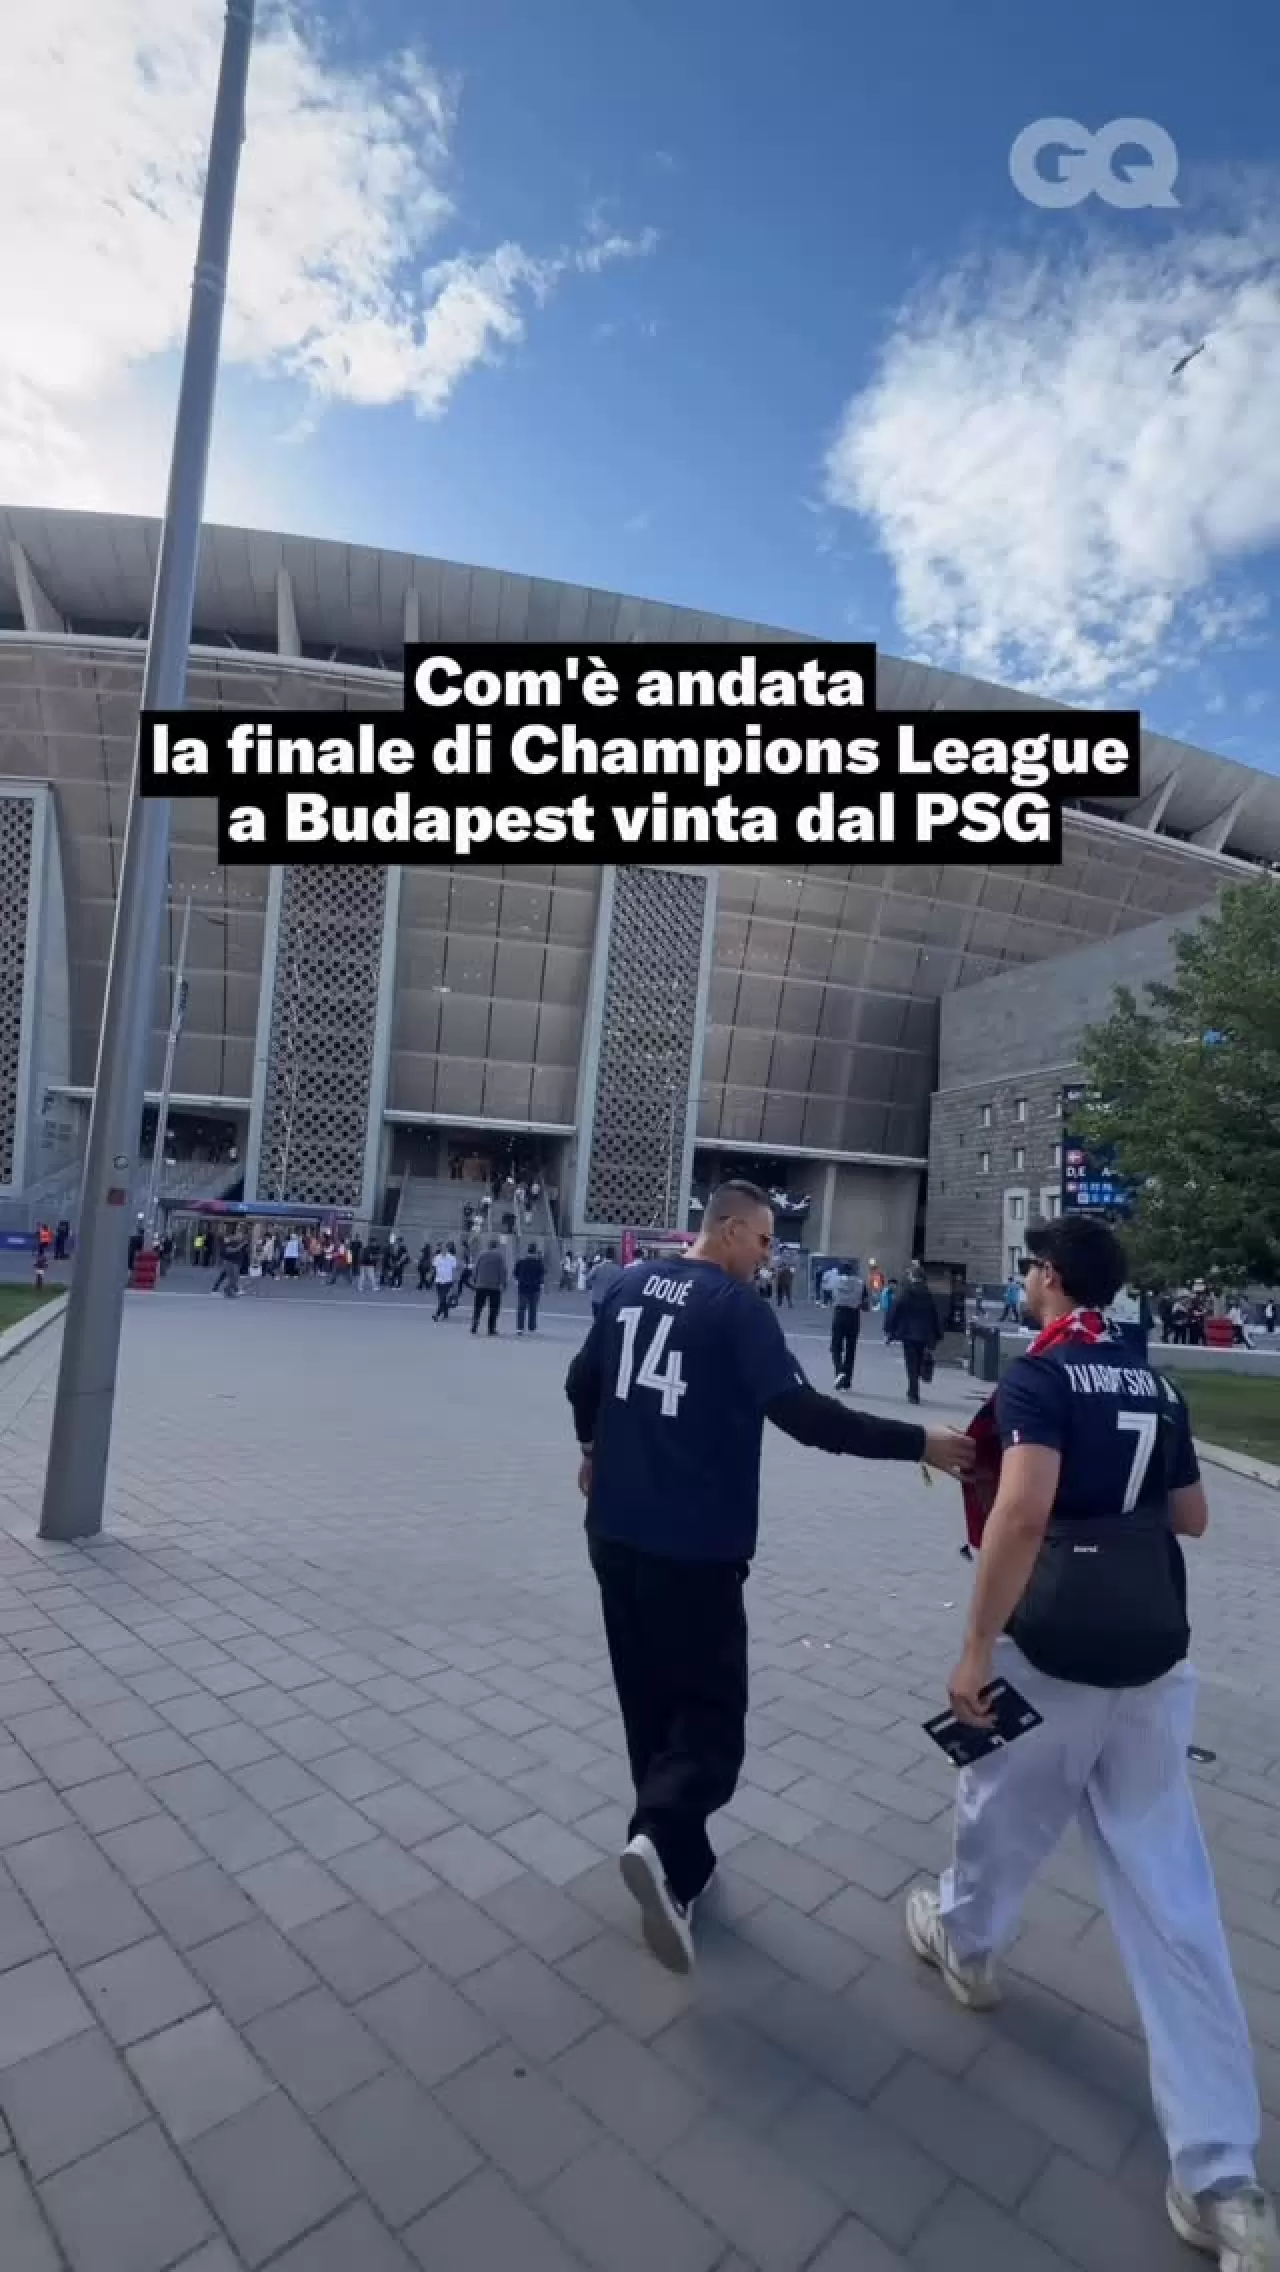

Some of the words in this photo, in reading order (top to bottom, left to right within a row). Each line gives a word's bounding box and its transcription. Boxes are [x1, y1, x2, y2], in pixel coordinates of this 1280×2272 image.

[642, 1273, 694, 1306] DOUÉ
[615, 1306, 688, 1417] 14
[1116, 1409, 1158, 1514] 7
